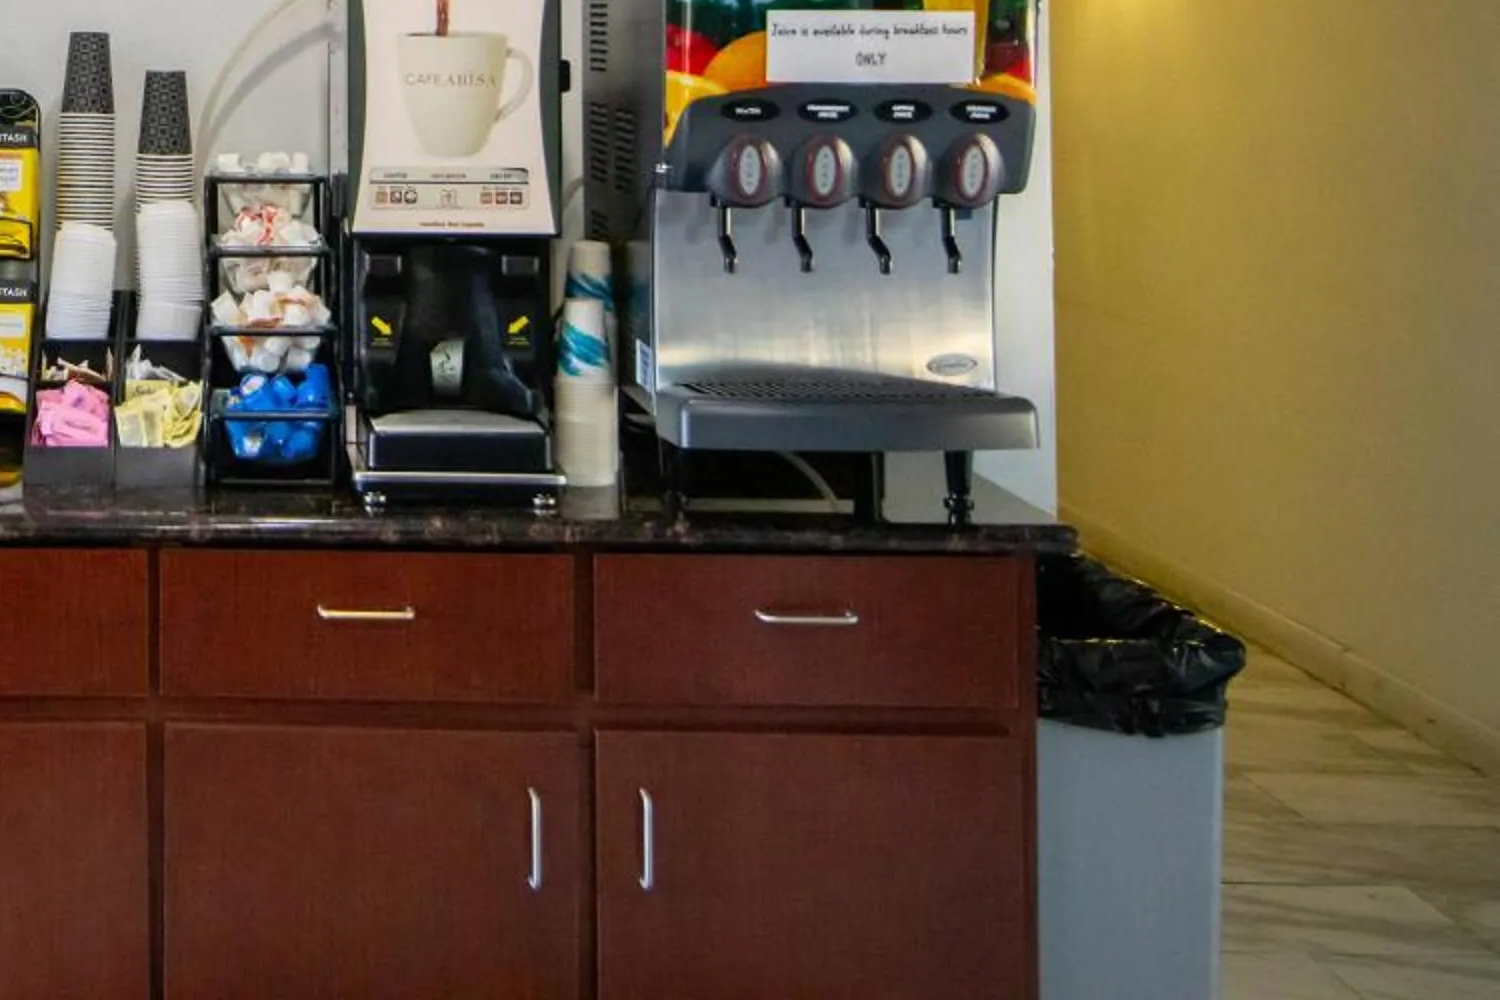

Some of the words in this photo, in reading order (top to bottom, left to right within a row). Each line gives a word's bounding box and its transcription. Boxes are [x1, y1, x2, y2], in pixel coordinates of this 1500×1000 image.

[771, 23, 797, 37] Juice
[813, 23, 855, 36] available
[859, 23, 890, 39] during
[893, 23, 938, 35] breakfast
[941, 23, 968, 35] hours
[855, 52, 887, 66] ONLY
